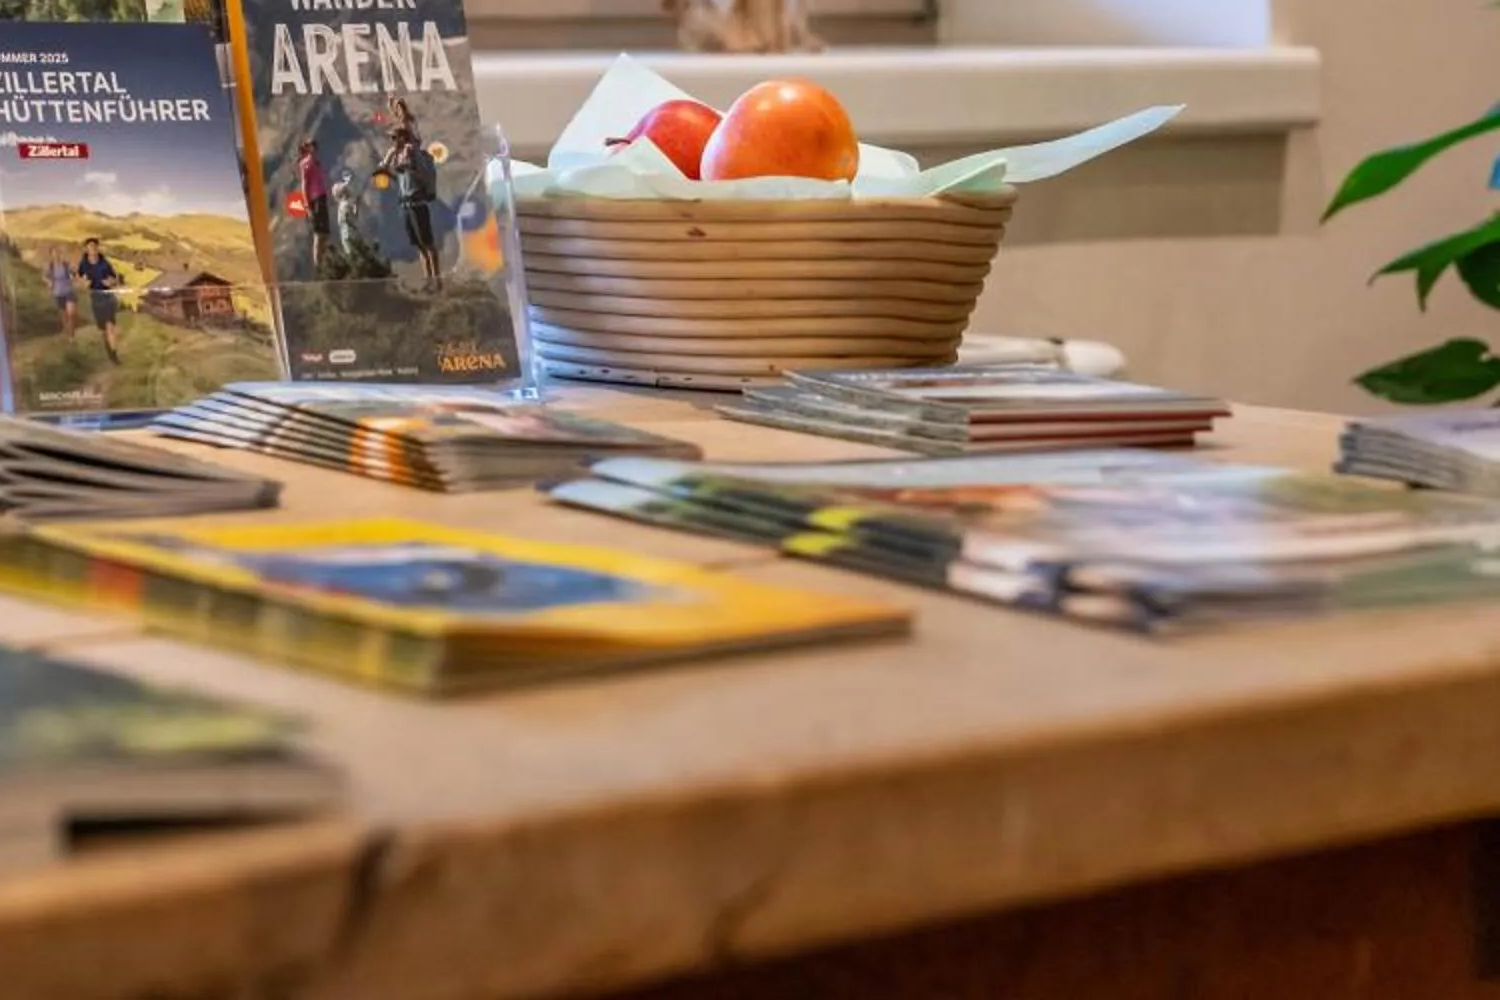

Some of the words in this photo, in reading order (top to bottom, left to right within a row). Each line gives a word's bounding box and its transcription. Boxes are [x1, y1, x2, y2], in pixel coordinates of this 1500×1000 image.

[40, 52, 69, 64] 2025
[271, 21, 458, 95] ARENA
[27, 144, 80, 158] Zillertal
